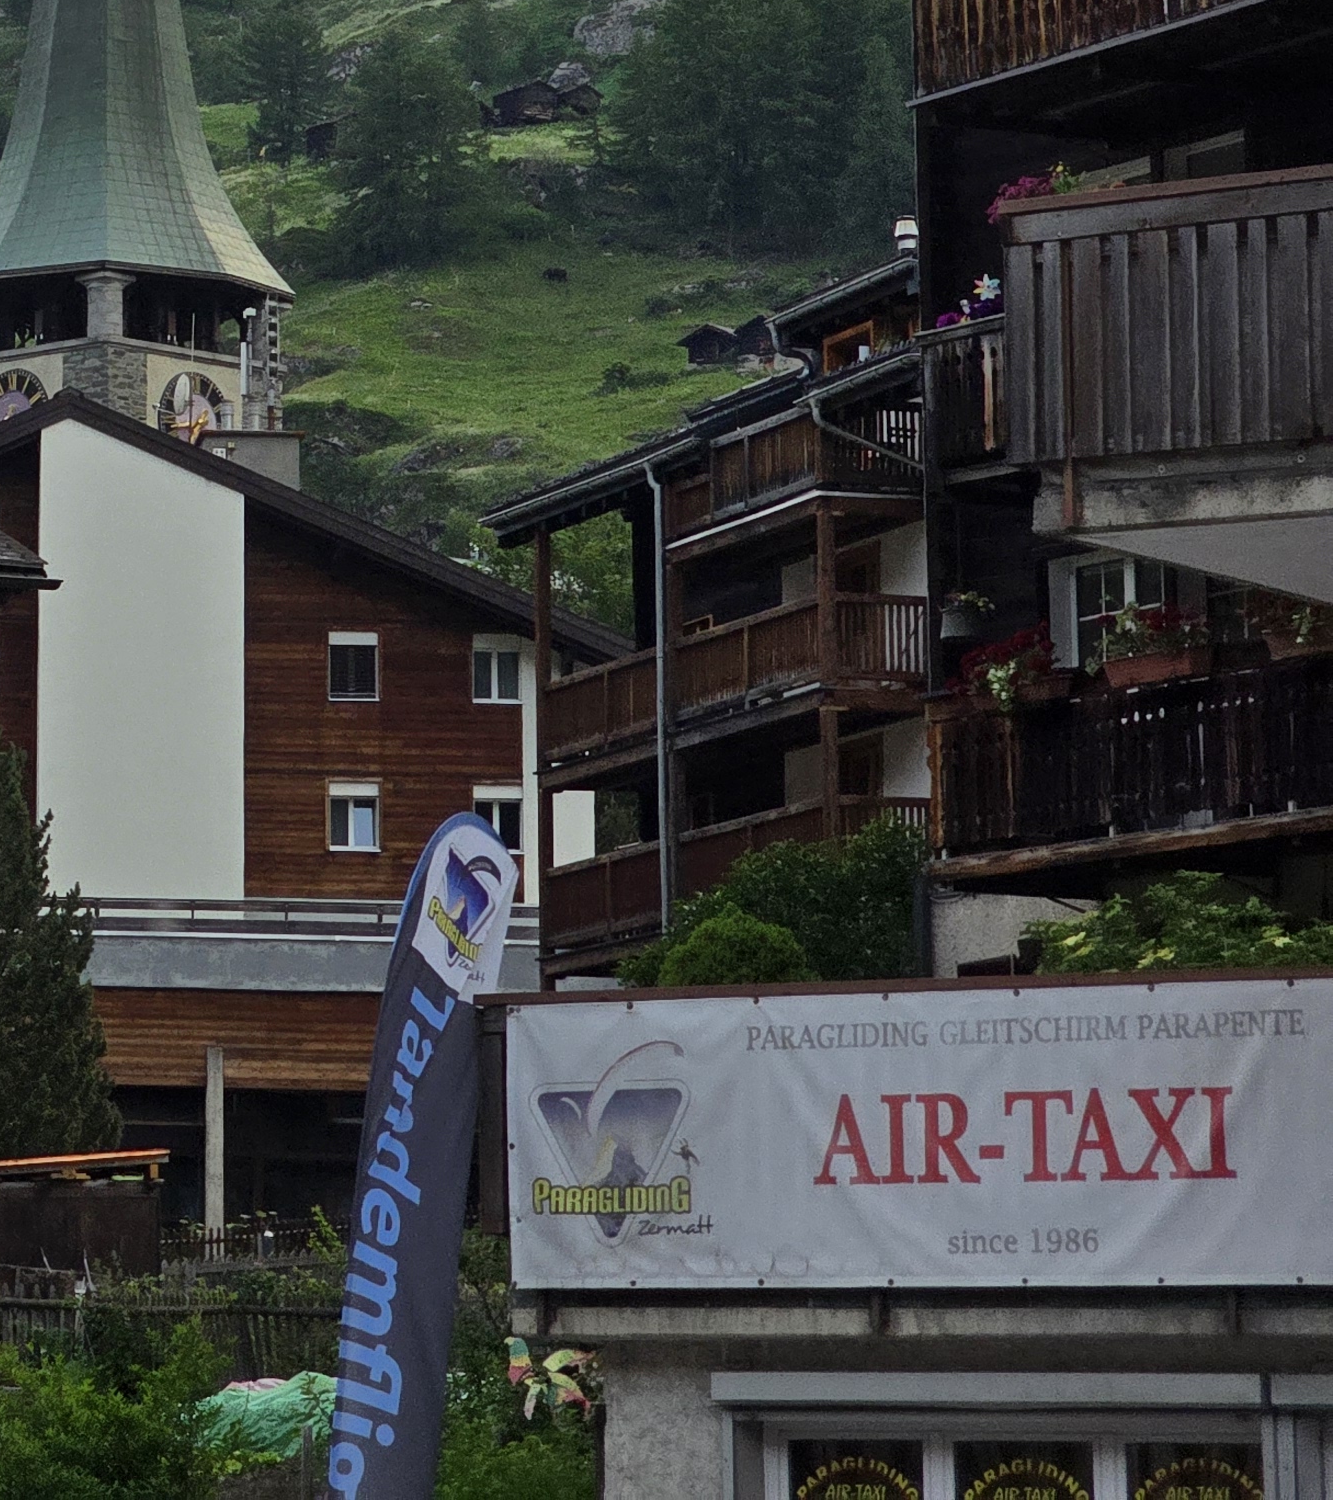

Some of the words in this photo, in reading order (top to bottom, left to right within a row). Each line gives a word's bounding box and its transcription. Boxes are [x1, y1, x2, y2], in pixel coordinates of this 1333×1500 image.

[427, 896, 482, 962] PARAGLIDIN
[746, 1019, 929, 1052] PARAGLIDING
[939, 1013, 1129, 1045] GLEITSCHIRM
[1137, 1008, 1306, 1041] PARAPENTE
[813, 1086, 1237, 1185] AIR-TAXI
[532, 1175, 692, 1215] PARAGLIDING
[638, 1214, 714, 1236] Zermatt
[947, 1230, 1019, 1255] since
[1031, 1228, 1100, 1254] 1986
